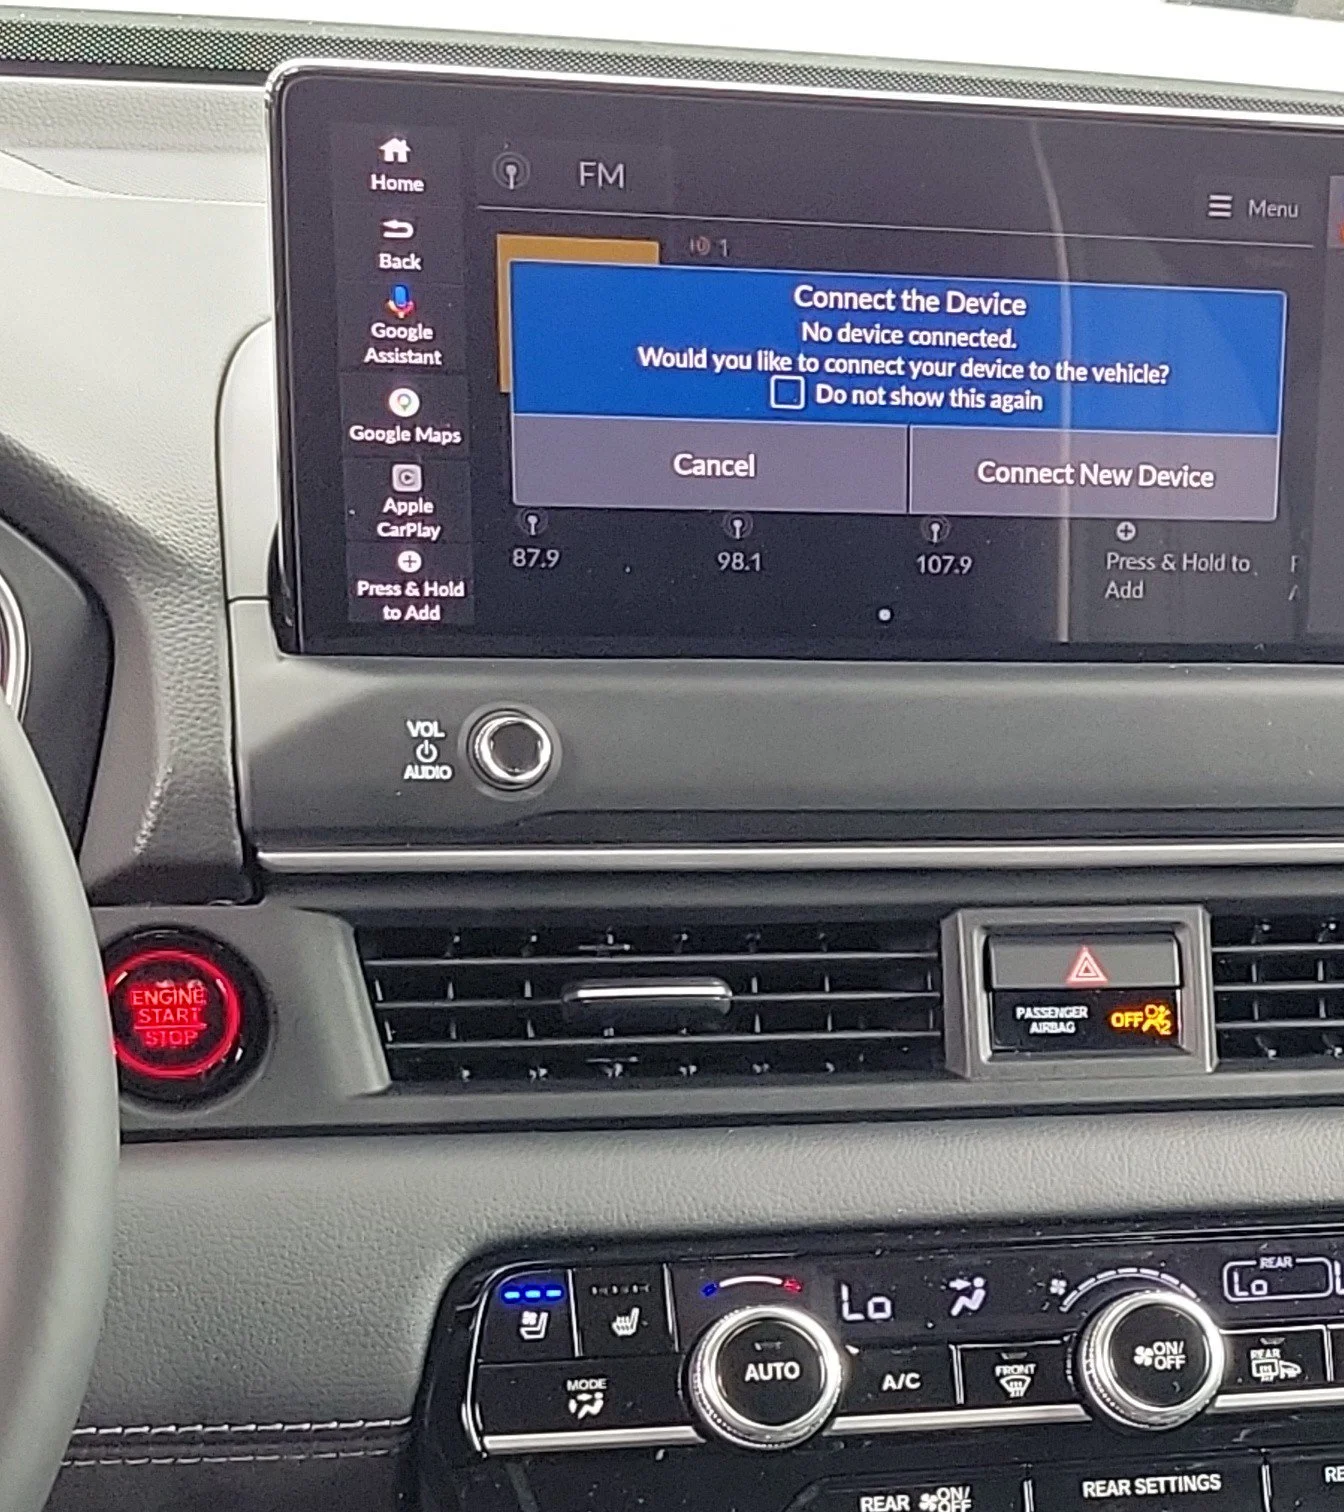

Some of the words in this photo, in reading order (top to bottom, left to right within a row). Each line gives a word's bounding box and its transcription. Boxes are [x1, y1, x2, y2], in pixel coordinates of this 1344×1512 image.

[370, 173, 424, 192] Home
[578, 162, 626, 189] FM
[1249, 199, 1298, 219] Menu
[378, 252, 422, 271] Back
[793, 284, 896, 311] Connect
[901, 288, 941, 313] the
[946, 291, 1027, 317] Device
[371, 323, 434, 344] Google
[802, 321, 833, 343] No
[837, 322, 904, 345] device
[908, 328, 1018, 349] connected.
[364, 347, 441, 367] Assistant
[637, 347, 707, 369] Would
[711, 352, 752, 374] you
[757, 350, 792, 371] like
[799, 354, 819, 373] to
[824, 355, 905, 376] connect
[910, 361, 957, 380] your
[960, 358, 1024, 380] device
[1029, 362, 1051, 380] to
[1055, 361, 1088, 382] the
[1092, 363, 1170, 384] vehicle?
[816, 383, 848, 405] Do
[852, 385, 887, 406] not
[890, 386, 944, 407] show
[950, 388, 985, 409] this
[990, 390, 1043, 413] again
[349, 425, 411, 446] Google
[415, 425, 462, 446] Maps
[673, 453, 756, 478] Cancel
[977, 460, 1075, 486] Connect
[1081, 463, 1133, 487] New
[1138, 464, 1215, 488] Device
[382, 497, 434, 517] Apple
[376, 521, 441, 541] CarPlay
[511, 547, 561, 569] 87.9
[716, 551, 762, 573] 98.1
[915, 553, 973, 576] 107.9
[1106, 552, 1156, 570] Press
[1161, 553, 1177, 571] &
[1182, 552, 1226, 572] Hold
[1231, 555, 1251, 572] to
[356, 580, 401, 598] Press
[404, 580, 419, 598] &
[422, 580, 465, 599] Hold
[1104, 580, 1145, 599] Add
[382, 605, 401, 621] to
[403, 604, 441, 622] Add
[407, 720, 445, 739] VOL
[403, 764, 452, 781] AUDIO
[132, 986, 206, 1005] ENGINE
[138, 1006, 201, 1024] START
[1016, 1005, 1089, 1020] PASSENGER
[1110, 1010, 1144, 1028] OFF
[145, 1028, 197, 1047] STOP
[1029, 1021, 1076, 1034] AIRBAG
[1259, 1256, 1293, 1269] REAR
[1154, 1354, 1187, 1369] OFF
[1249, 1347, 1281, 1360] REAR
[744, 1360, 800, 1382] AUTO
[995, 1363, 1036, 1377] FRONT
[566, 1378, 607, 1392] MODE
[881, 1371, 921, 1392] A/C
[1082, 1479, 1131, 1498] REAR
[1134, 1474, 1222, 1495] SETTINGS
